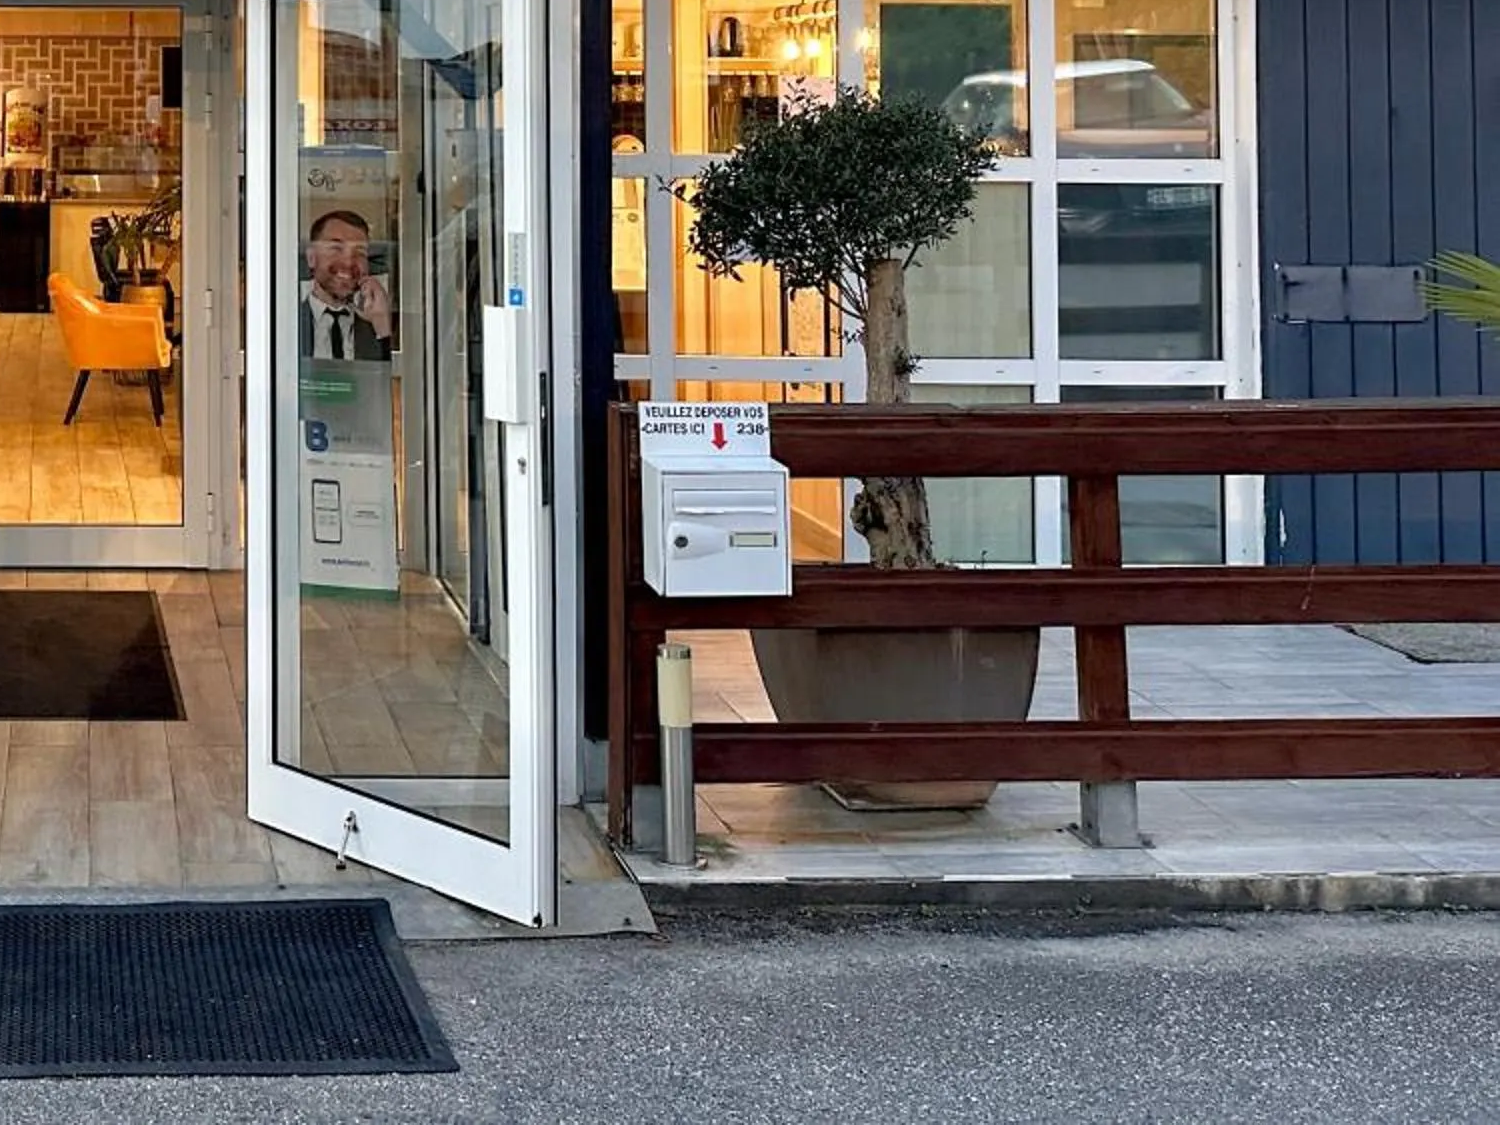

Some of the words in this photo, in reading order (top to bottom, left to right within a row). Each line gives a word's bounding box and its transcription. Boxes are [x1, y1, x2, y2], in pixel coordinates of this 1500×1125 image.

[645, 406, 692, 418] VEUILLEZ
[694, 406, 740, 418] DEPOSER
[742, 406, 764, 418] VOS
[645, 422, 687, 434] CARTES
[689, 423, 705, 434] ICI
